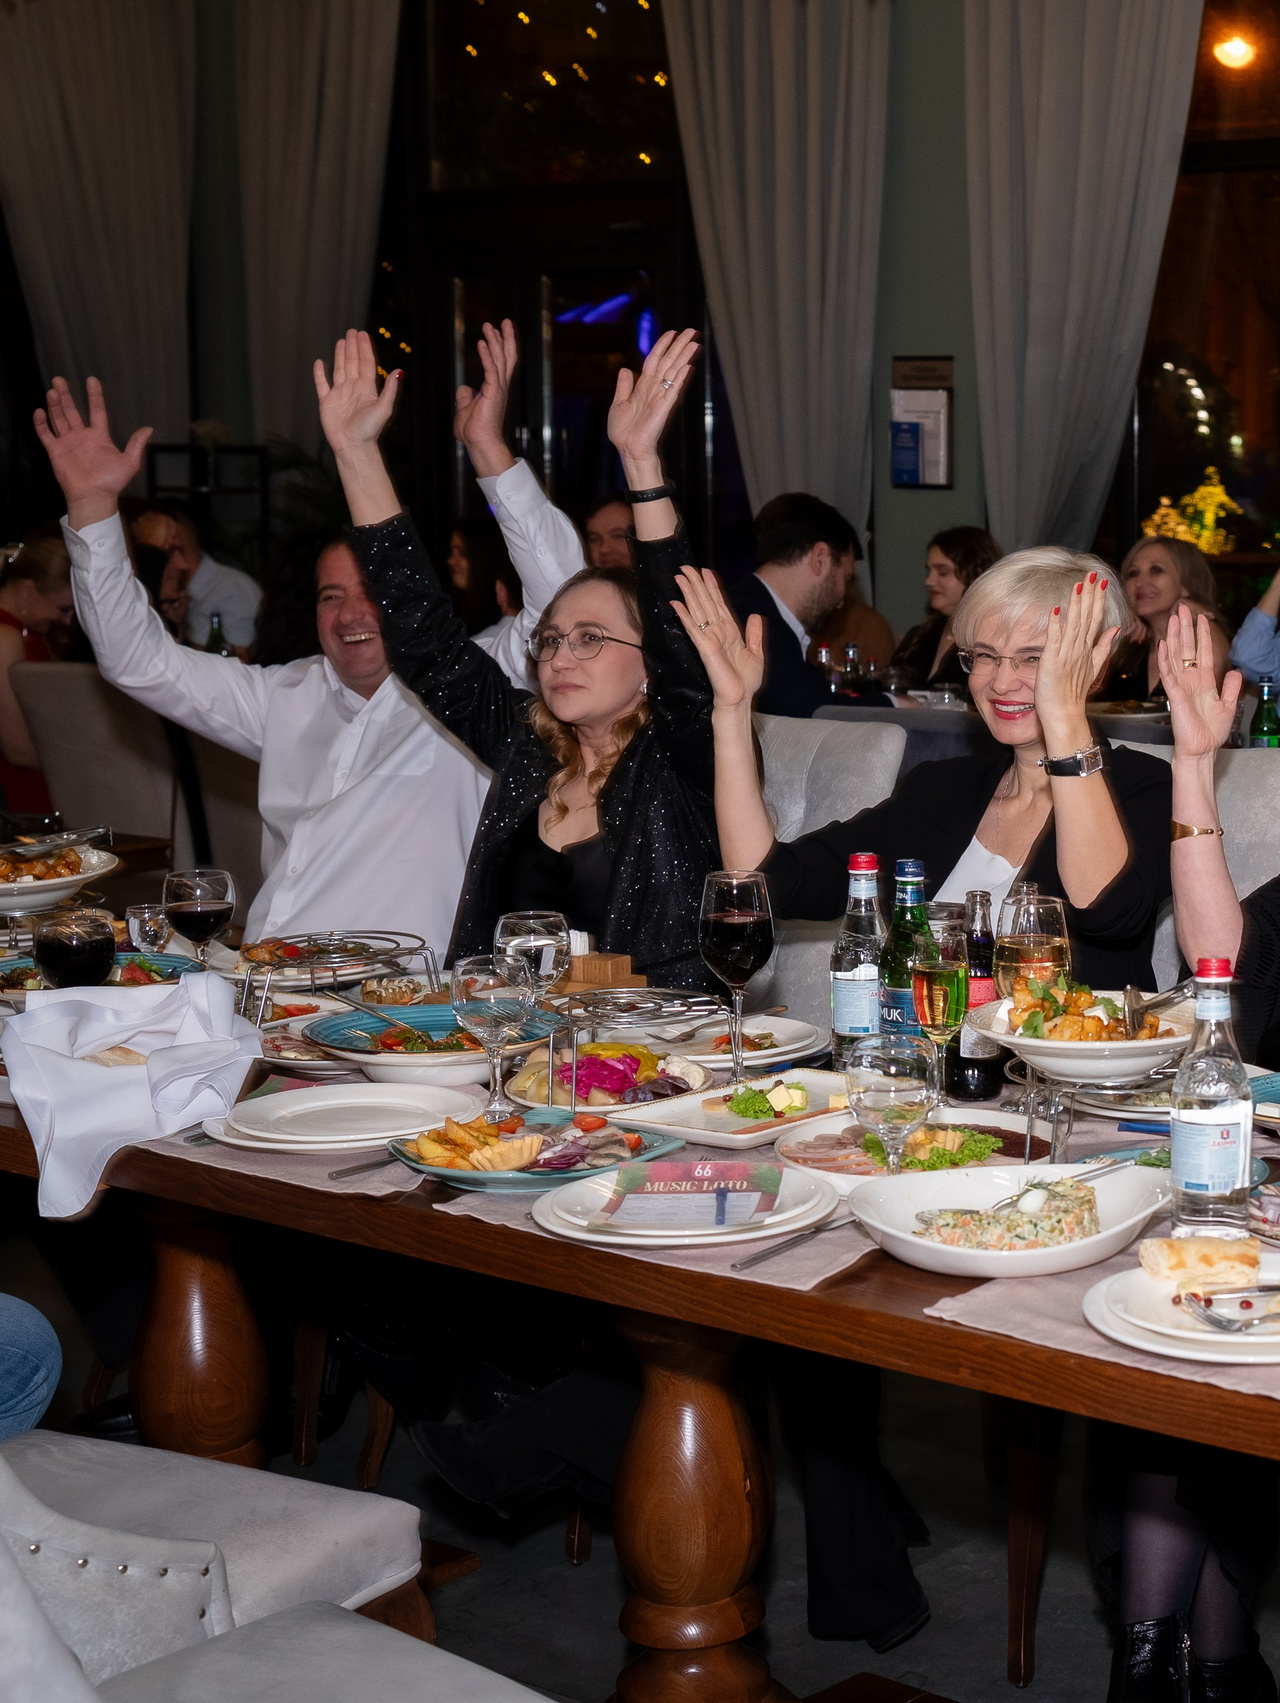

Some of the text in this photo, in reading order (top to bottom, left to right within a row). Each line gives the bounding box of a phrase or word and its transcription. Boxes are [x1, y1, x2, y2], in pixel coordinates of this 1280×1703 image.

[694, 1164, 712, 1177] 66
[643, 1180, 748, 1192] MUSIC LOTO
